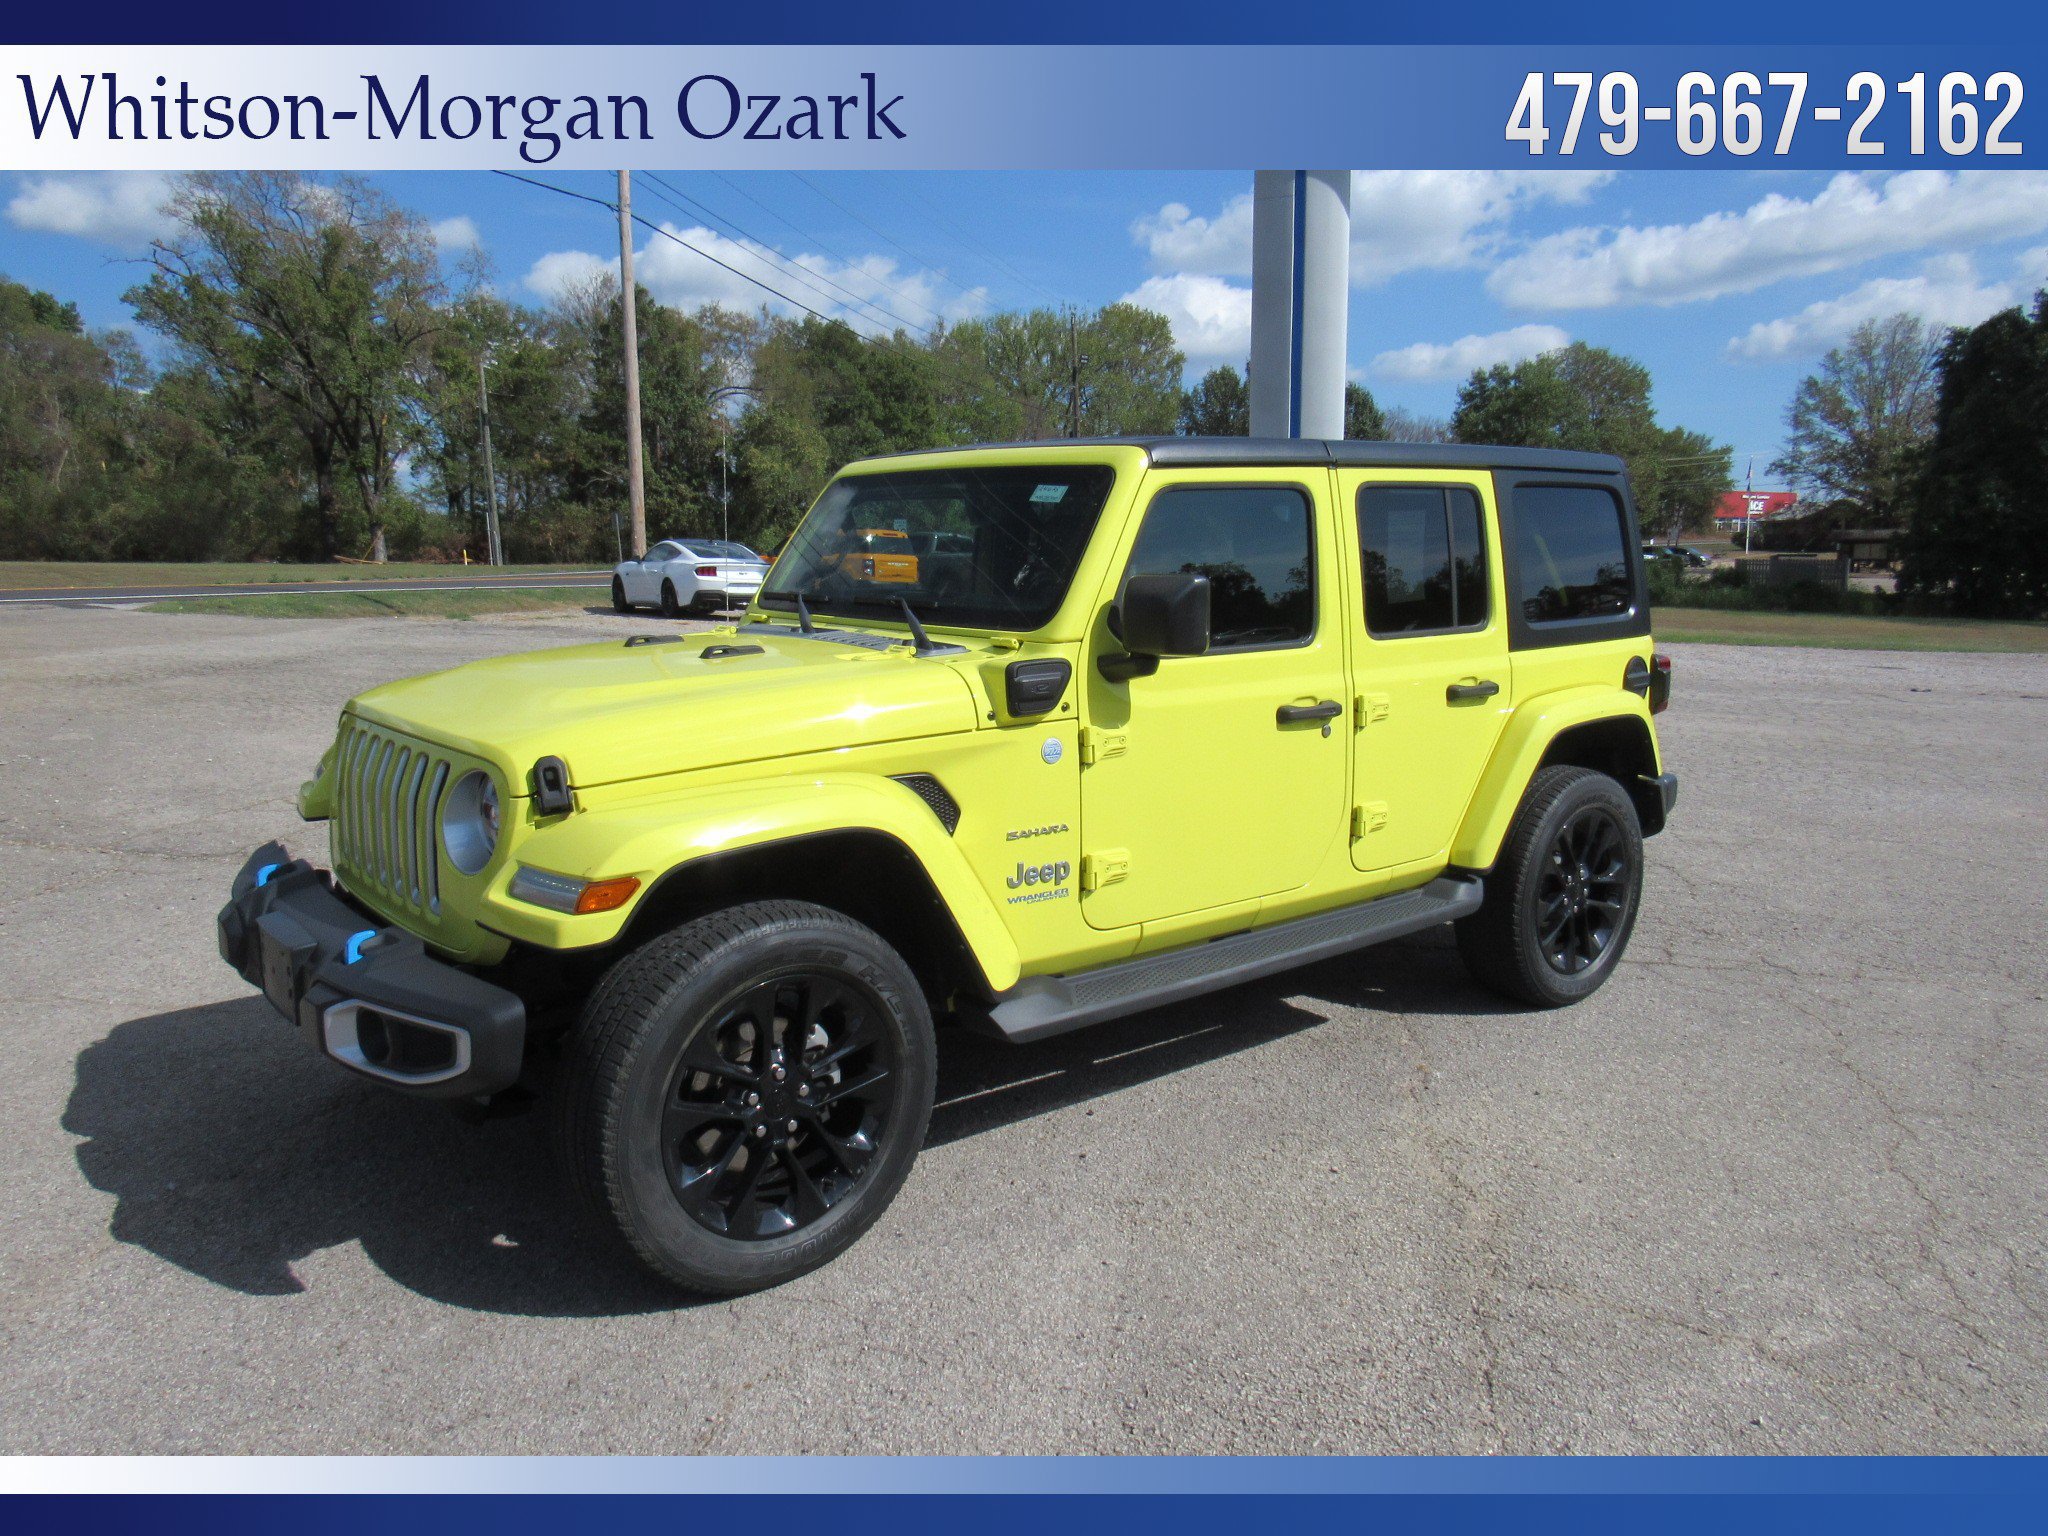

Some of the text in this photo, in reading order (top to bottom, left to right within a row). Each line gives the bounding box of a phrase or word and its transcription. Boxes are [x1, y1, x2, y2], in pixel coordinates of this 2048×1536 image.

[1006, 823, 1069, 841] SAHARA
[1007, 860, 1070, 889] Jeep
[1007, 887, 1069, 905] WRANGLER
